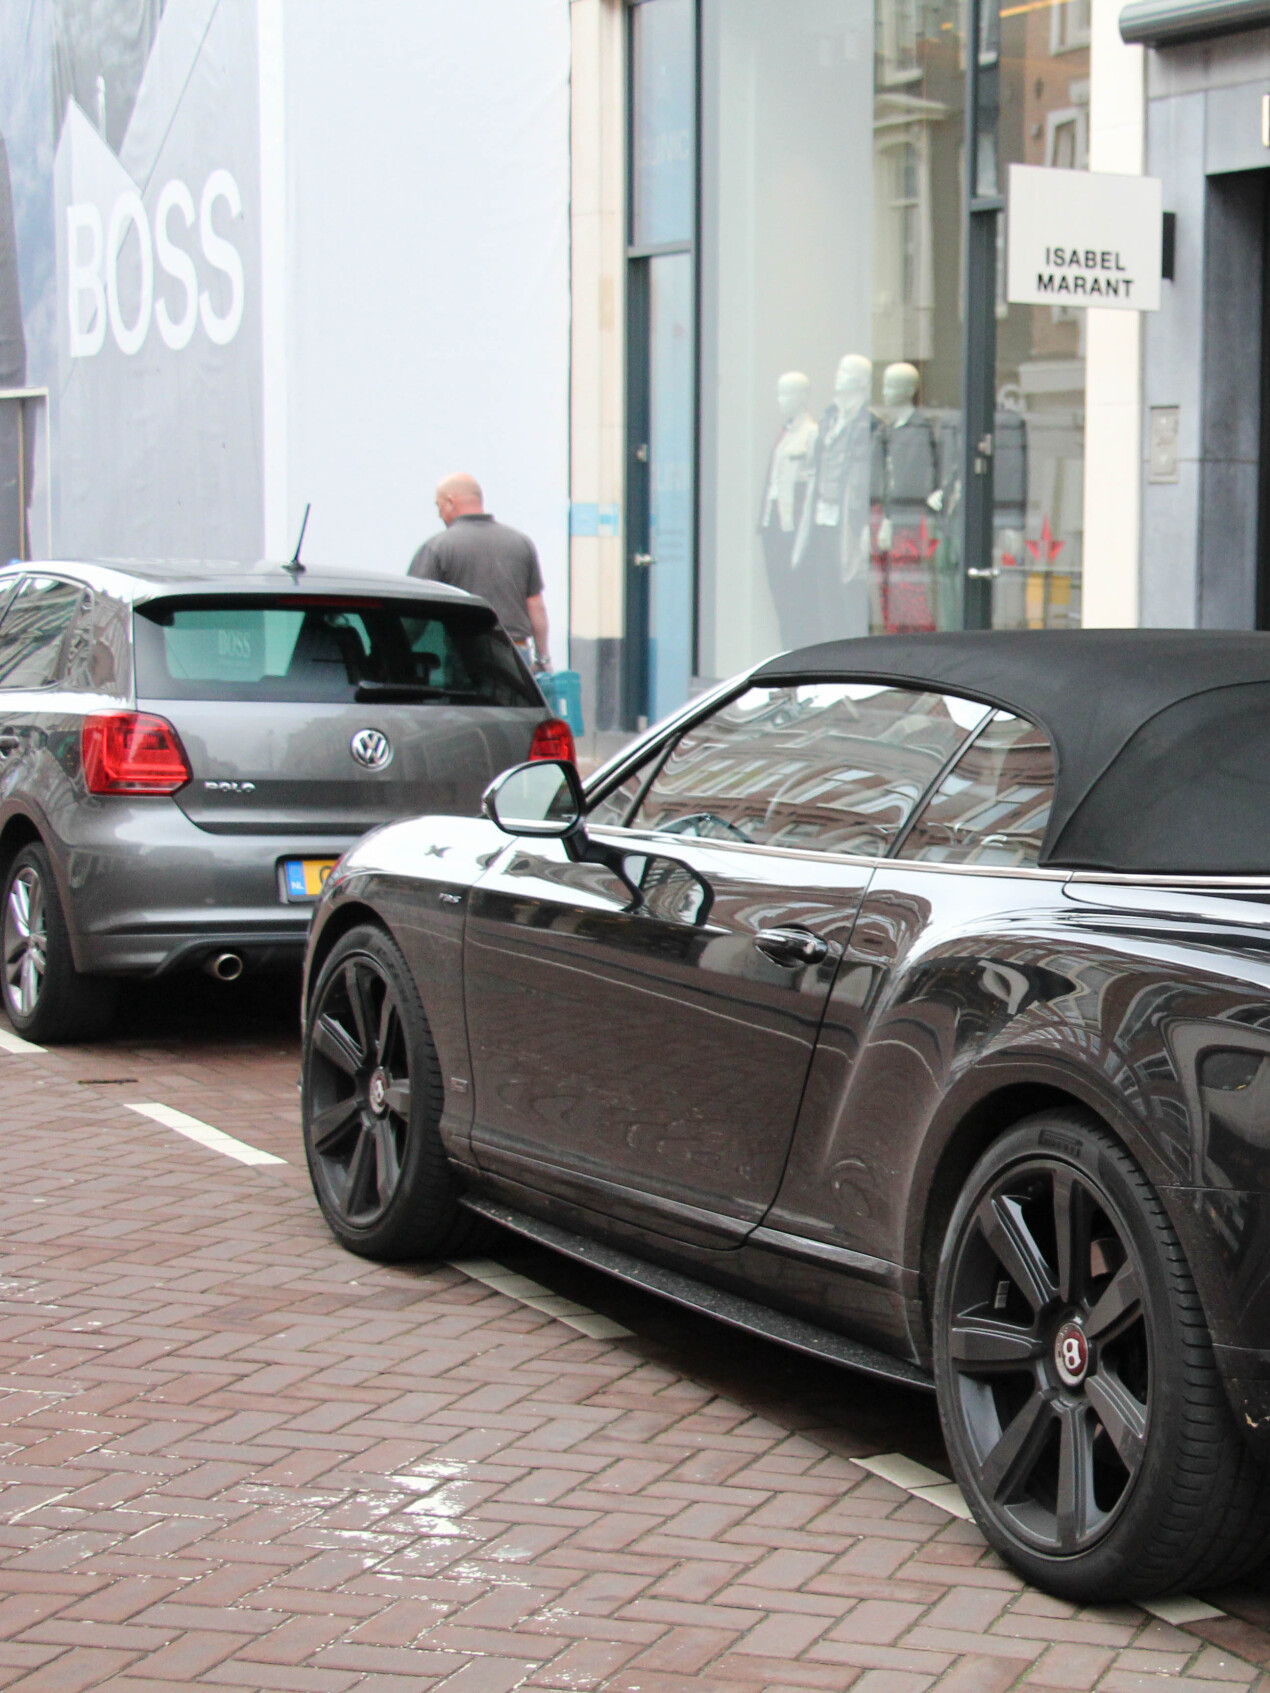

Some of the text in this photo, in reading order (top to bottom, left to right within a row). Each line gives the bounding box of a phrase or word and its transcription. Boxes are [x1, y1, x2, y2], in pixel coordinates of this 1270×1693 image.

[67, 168, 244, 358] BOSS
[1046, 247, 1125, 271] ISABEL
[1037, 273, 1134, 298] MARANT
[203, 781, 255, 793] POLO
